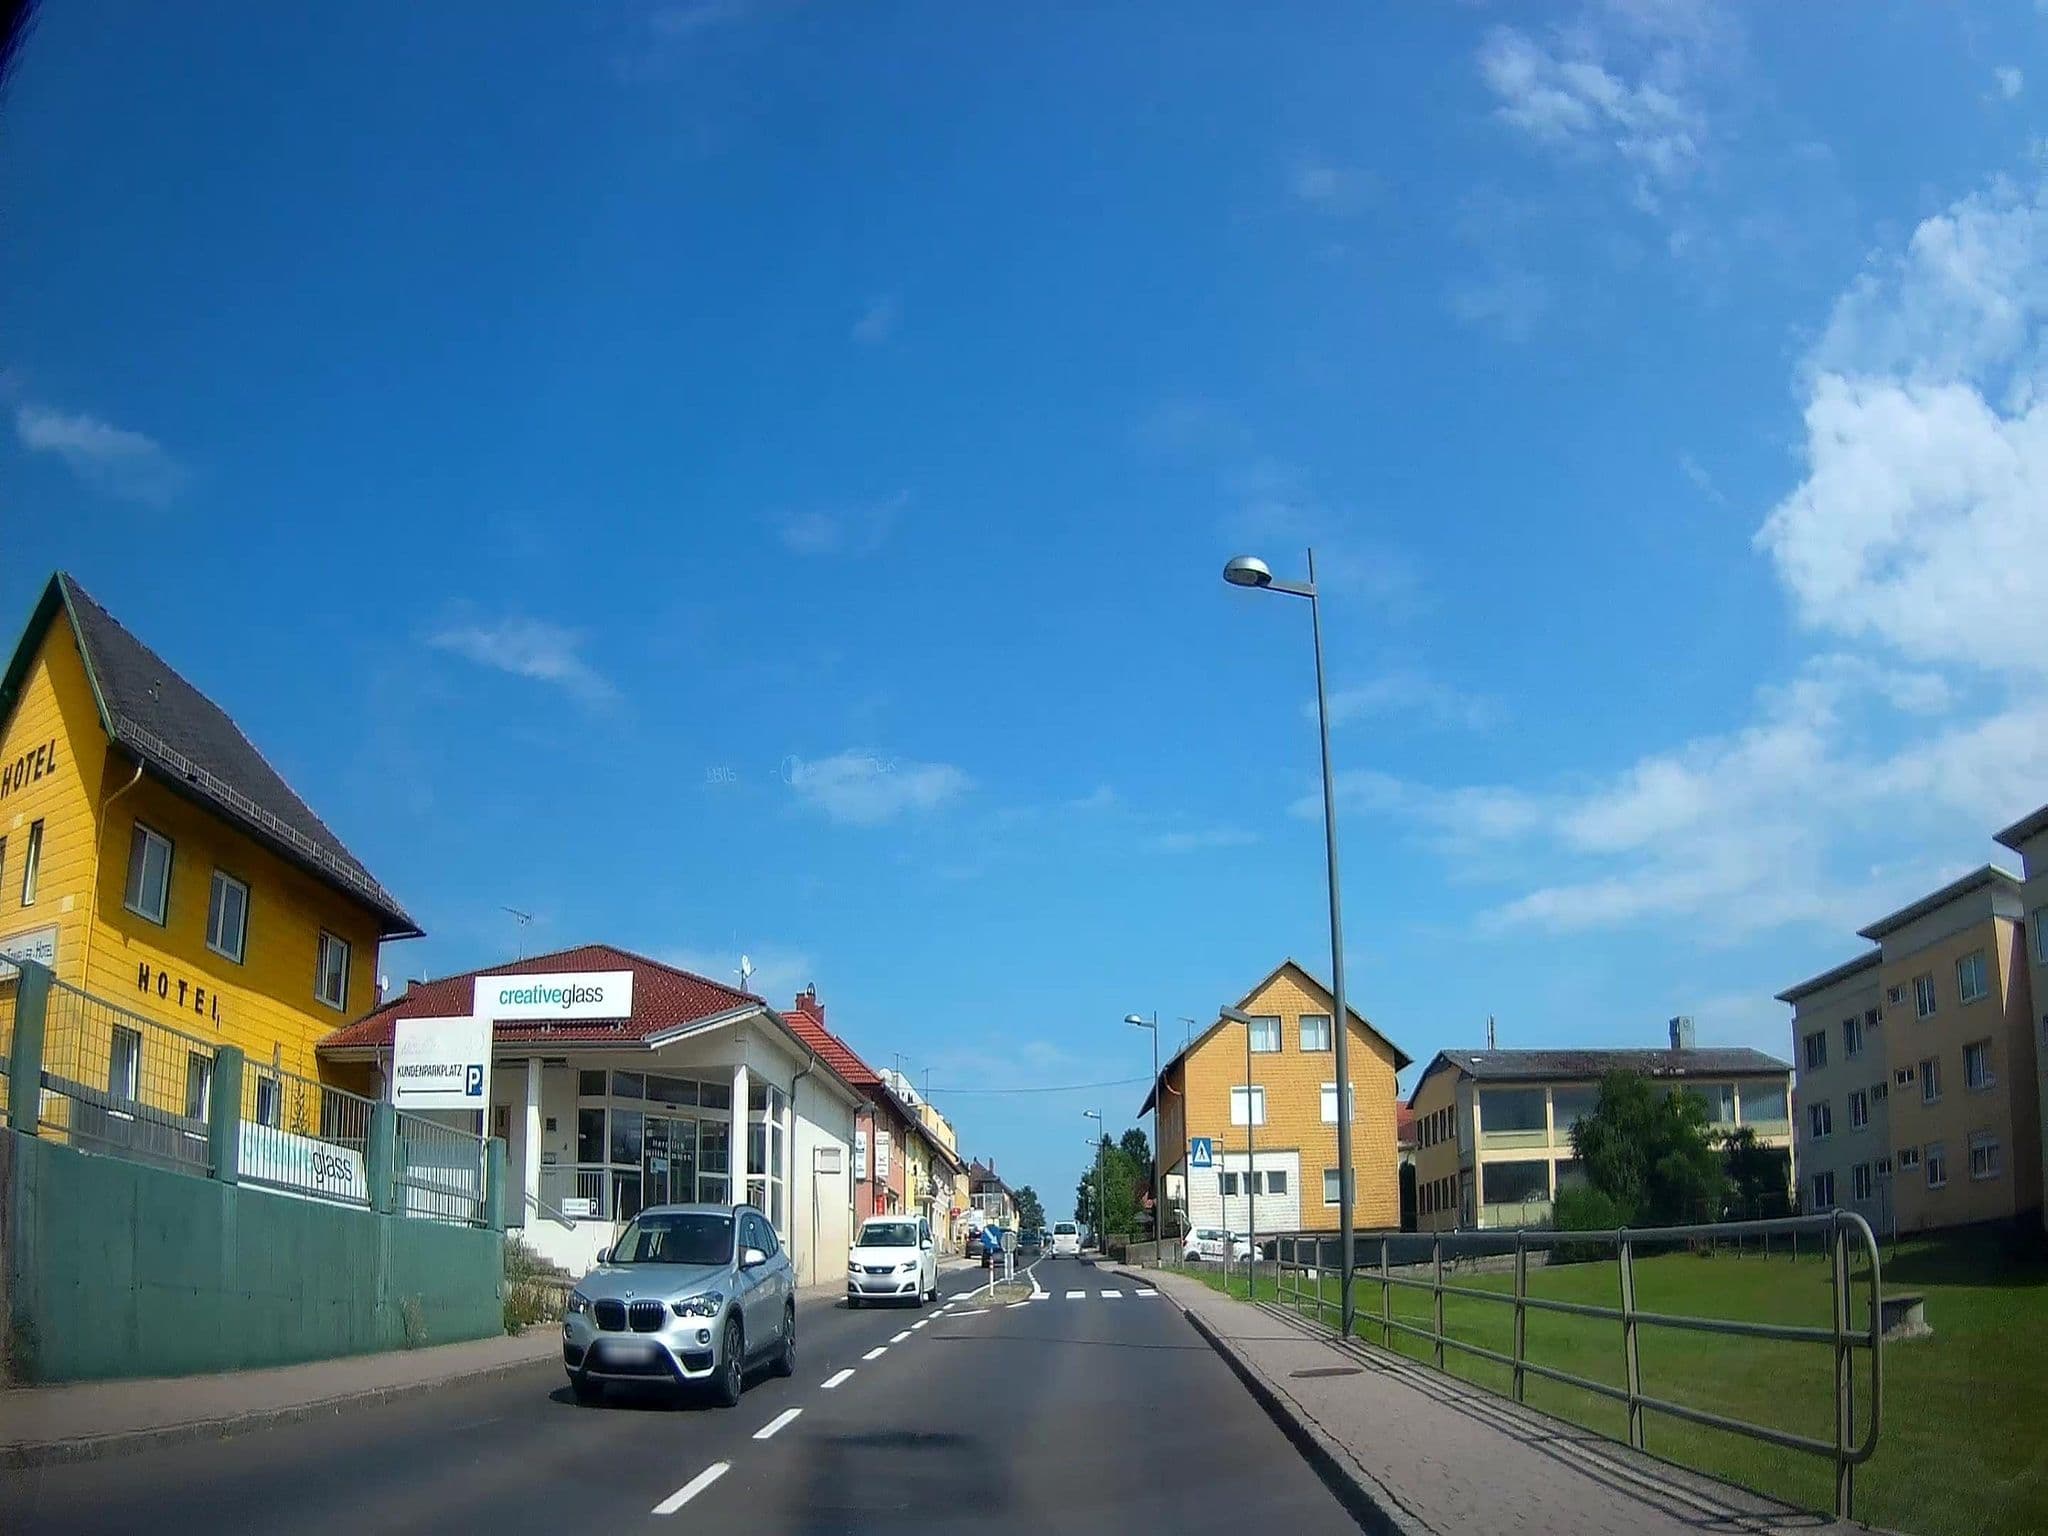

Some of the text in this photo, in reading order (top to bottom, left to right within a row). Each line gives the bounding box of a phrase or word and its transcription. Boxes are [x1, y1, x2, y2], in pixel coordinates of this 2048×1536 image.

[0, 738, 56, 800] HOTEL
[138, 961, 220, 1031] HOTEL
[499, 983, 604, 1009] creativeglass
[397, 1064, 463, 1078] KUNDENPARKPLATZ
